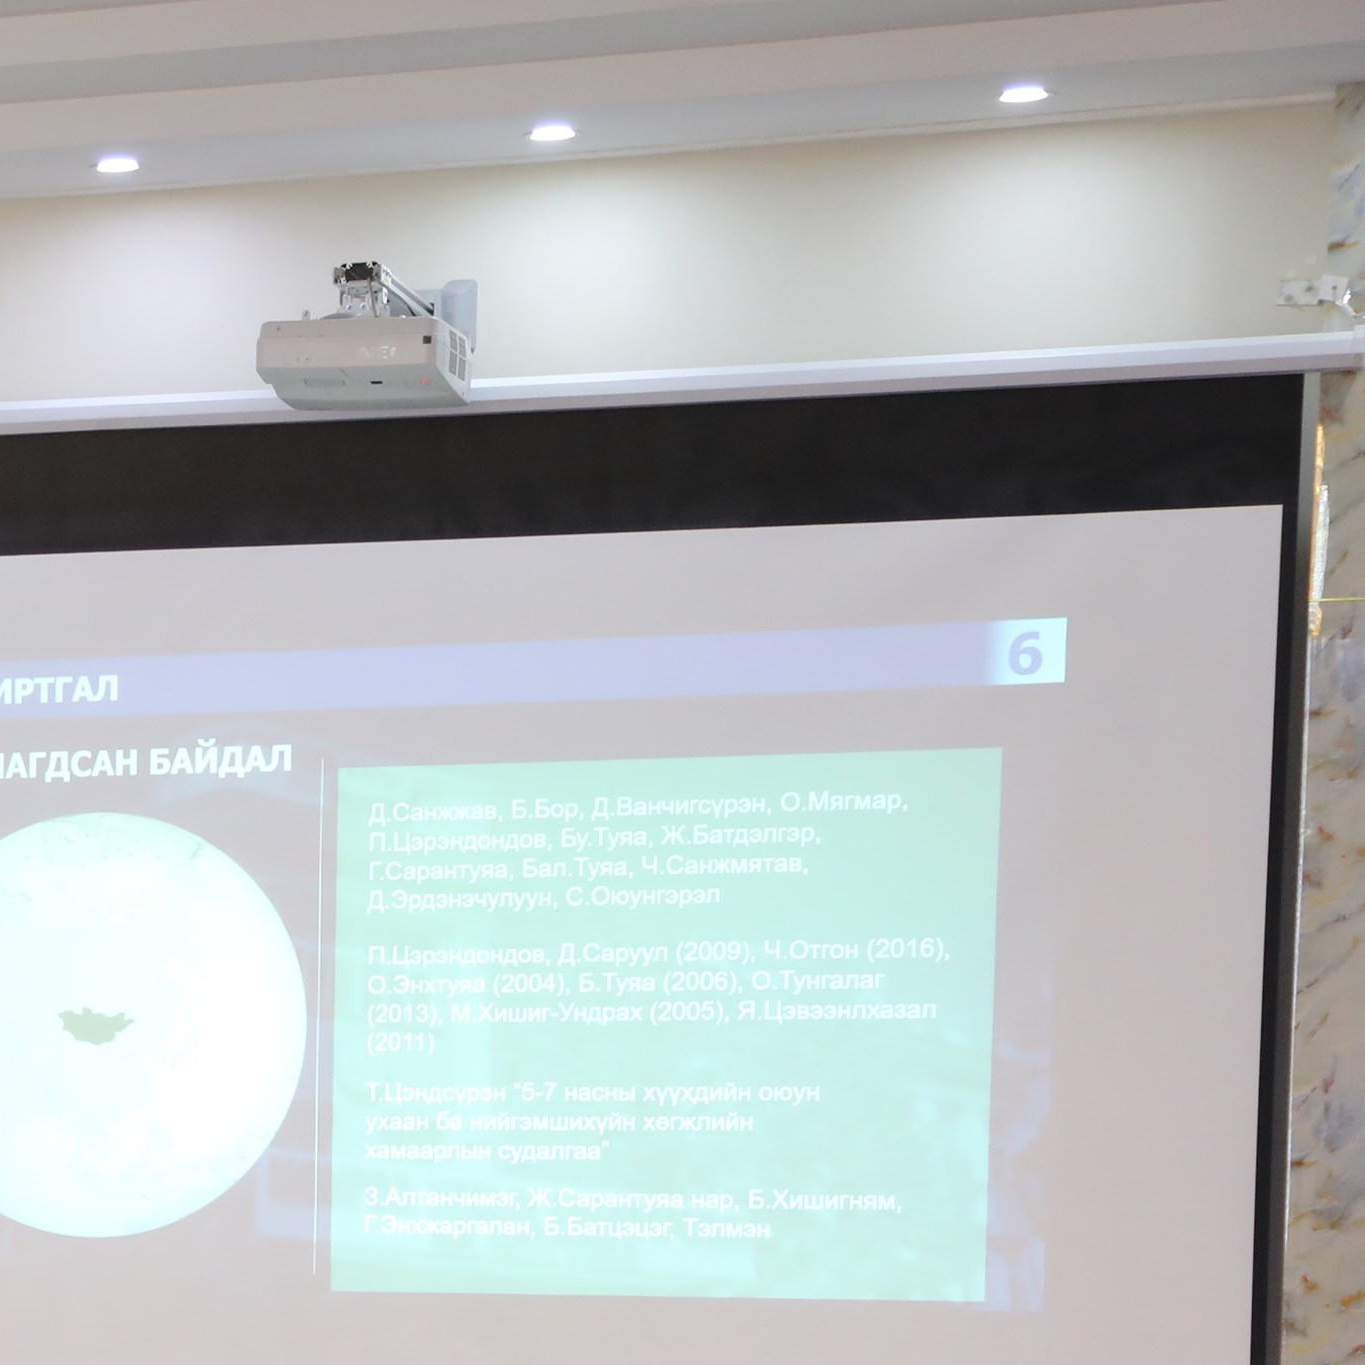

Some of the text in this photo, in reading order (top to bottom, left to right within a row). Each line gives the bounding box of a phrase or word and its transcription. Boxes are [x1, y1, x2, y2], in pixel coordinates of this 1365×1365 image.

[1008, 630, 1043, 676] 6
[149, 738, 293, 778] БАЙДАЛ
[511, 798, 585, 821] Б.Бор,
[780, 790, 908, 815] О.Мягмар,
[369, 824, 822, 856] П.Цэрэндондов, Бу.Туяа, Ж.Батдэлгэр,
[368, 854, 809, 885] Г.Сарантуяа, Бал.Туяа, Ч.Санжмятав,
[367, 885, 722, 914] Д.Эрдэнэчулуун, С.Оюунгэрэл
[557, 942, 668, 967] Д.Саруул
[675, 940, 757, 966] (2009),
[763, 939, 859, 960] Ч.Отгон
[867, 936, 951, 963] (2016),
[367, 968, 885, 998] О.Энхтуяа (2004), Б.Туяа (2006), О.Тунгалаг
[367, 1002, 443, 1028] (2013),
[649, 1000, 730, 1026] (2005),
[366, 1031, 436, 1057] (2011)
[564, 1086, 636, 1102] насны
[643, 1082, 752, 1106] хүүхдийн
[758, 1085, 820, 1107] оюун
[365, 1115, 429, 1136] ухаан
[436, 1110, 463, 1132] ба
[643, 1111, 753, 1132] хөгжлийн
[364, 1144, 492, 1165] хамаарлын
[527, 1186, 683, 1213] Ж.Сарантуяа
[691, 1193, 740, 1214] нар,
[748, 1188, 902, 1214] Б.Хишигням,
[682, 1217, 771, 1239] Тэлмэн
